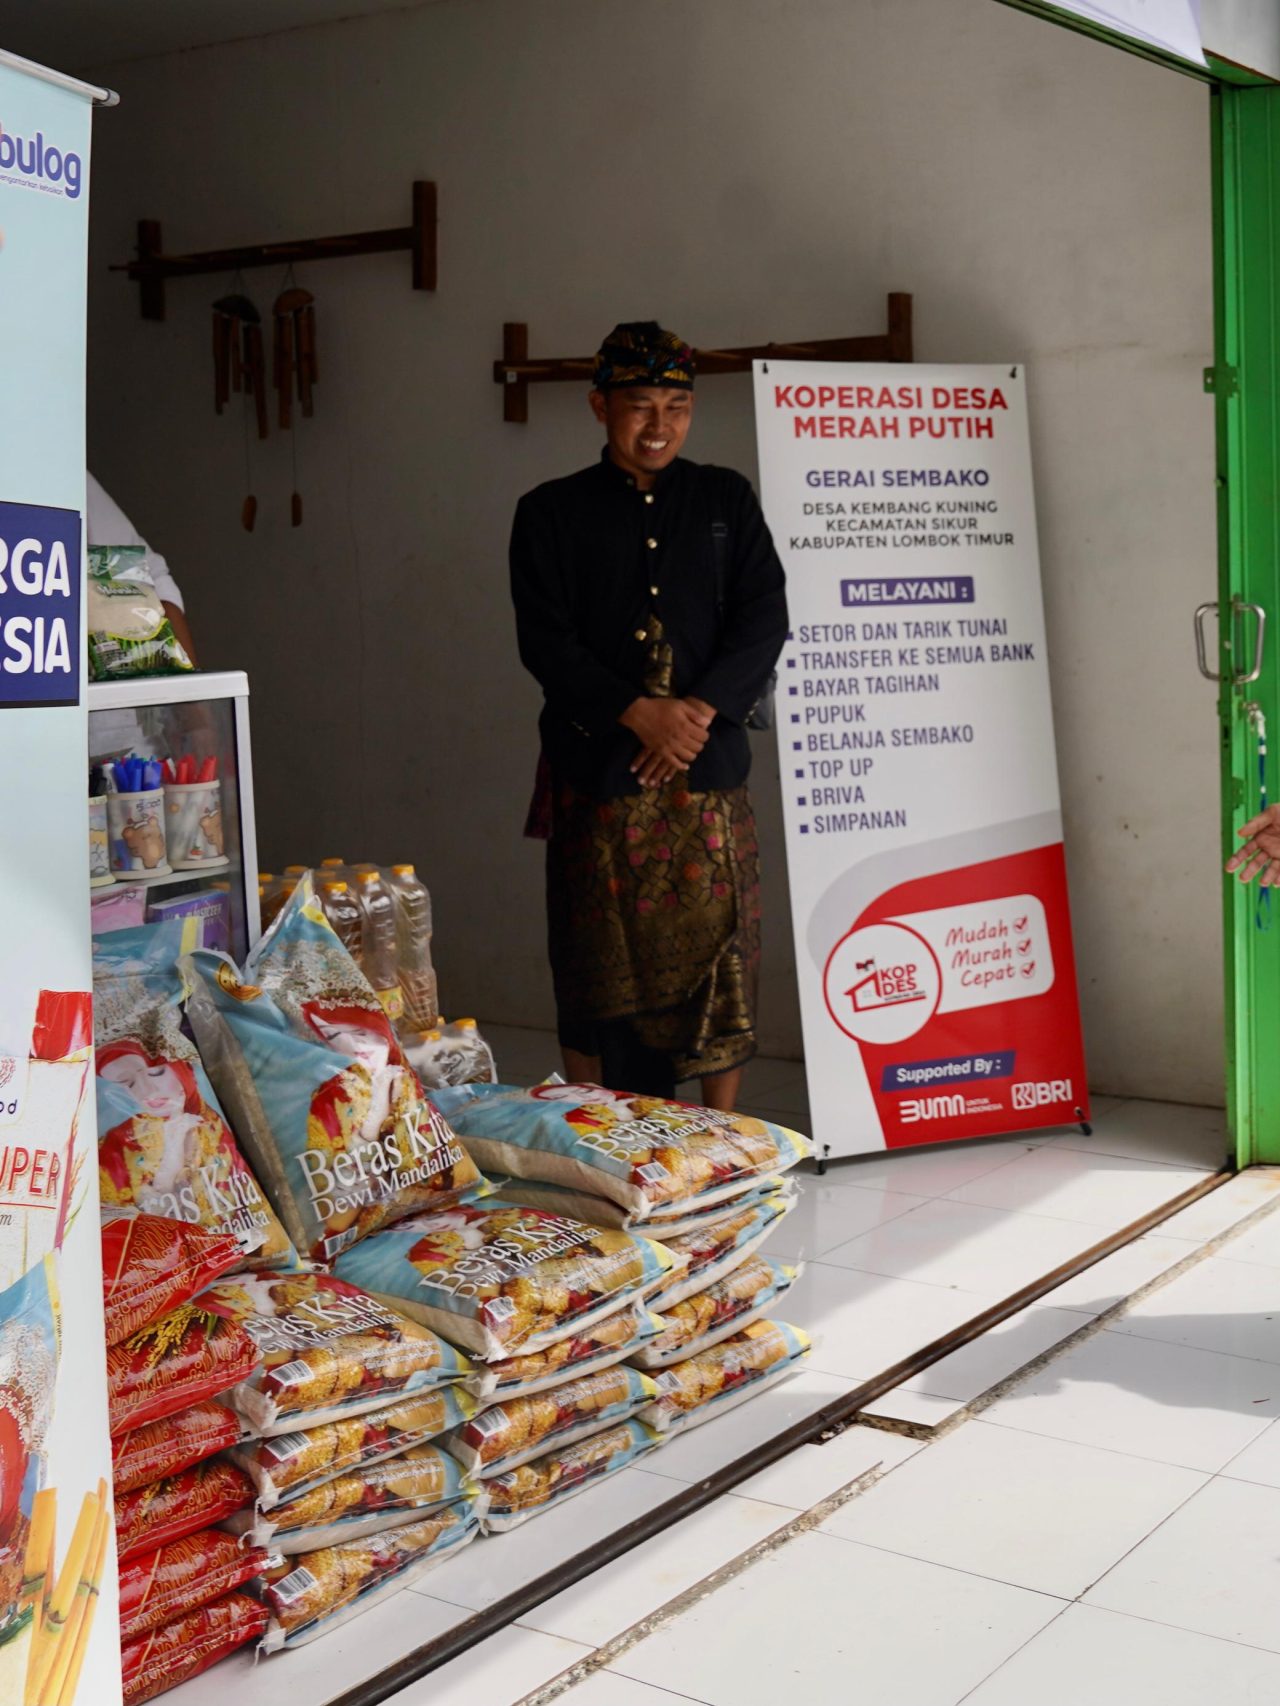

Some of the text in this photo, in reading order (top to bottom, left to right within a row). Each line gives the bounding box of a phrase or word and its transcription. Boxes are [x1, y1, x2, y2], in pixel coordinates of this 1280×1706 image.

[775, 385, 1008, 410] KOPERASI DESA
[794, 417, 994, 439] MERAH PUTIH
[806, 469, 990, 488] GERAI SEMBAKO
[803, 500, 998, 515] DESA KEMBANG KUNING
[826, 518, 979, 532] KECAMATAN SIKUR
[790, 533, 1014, 550] KABUPATEN LOMBOK TIMUR
[848, 581, 956, 602] MELAYANI
[800, 618, 1007, 643] SETOR DAN TARIK TUNAI
[0, 616, 71, 674] SIA
[801, 643, 1035, 670] TRANSFER KE SEMUA BANK
[804, 674, 939, 697] BAYAR TAGIHAN
[805, 704, 865, 725] PUPUK
[808, 725, 974, 752] BELANJA SEMBAKO
[809, 759, 874, 779] TOP UP
[811, 786, 865, 806] BRIVA
[814, 810, 907, 834] SIMPANAN
[945, 919, 1008, 947] Mudah
[951, 941, 1012, 969] Murah
[880, 964, 917, 981] KOP
[961, 963, 1016, 988] Cepat
[882, 977, 917, 996] DES
[896, 1060, 971, 1083] Supported
[974, 1058, 993, 1074] By
[1037, 1079, 1073, 1105] BRI
[574, 1114, 670, 1157] Beras
[609, 1112, 740, 1164] Dewi Mandalika
[294, 1106, 455, 1200] Beras Kita
[139, 1160, 262, 1224] ras Kita
[311, 1145, 464, 1223] Dewi Mandalika
[206, 1209, 270, 1234] ndalika
[417, 1238, 524, 1297] Beras
[502, 1216, 588, 1244] Kita
[452, 1267, 509, 1300] Dewi
[507, 1227, 603, 1272] Mandalika
[242, 1292, 389, 1340] eras Kita
[261, 1312, 405, 1354] ewi Mandalika
